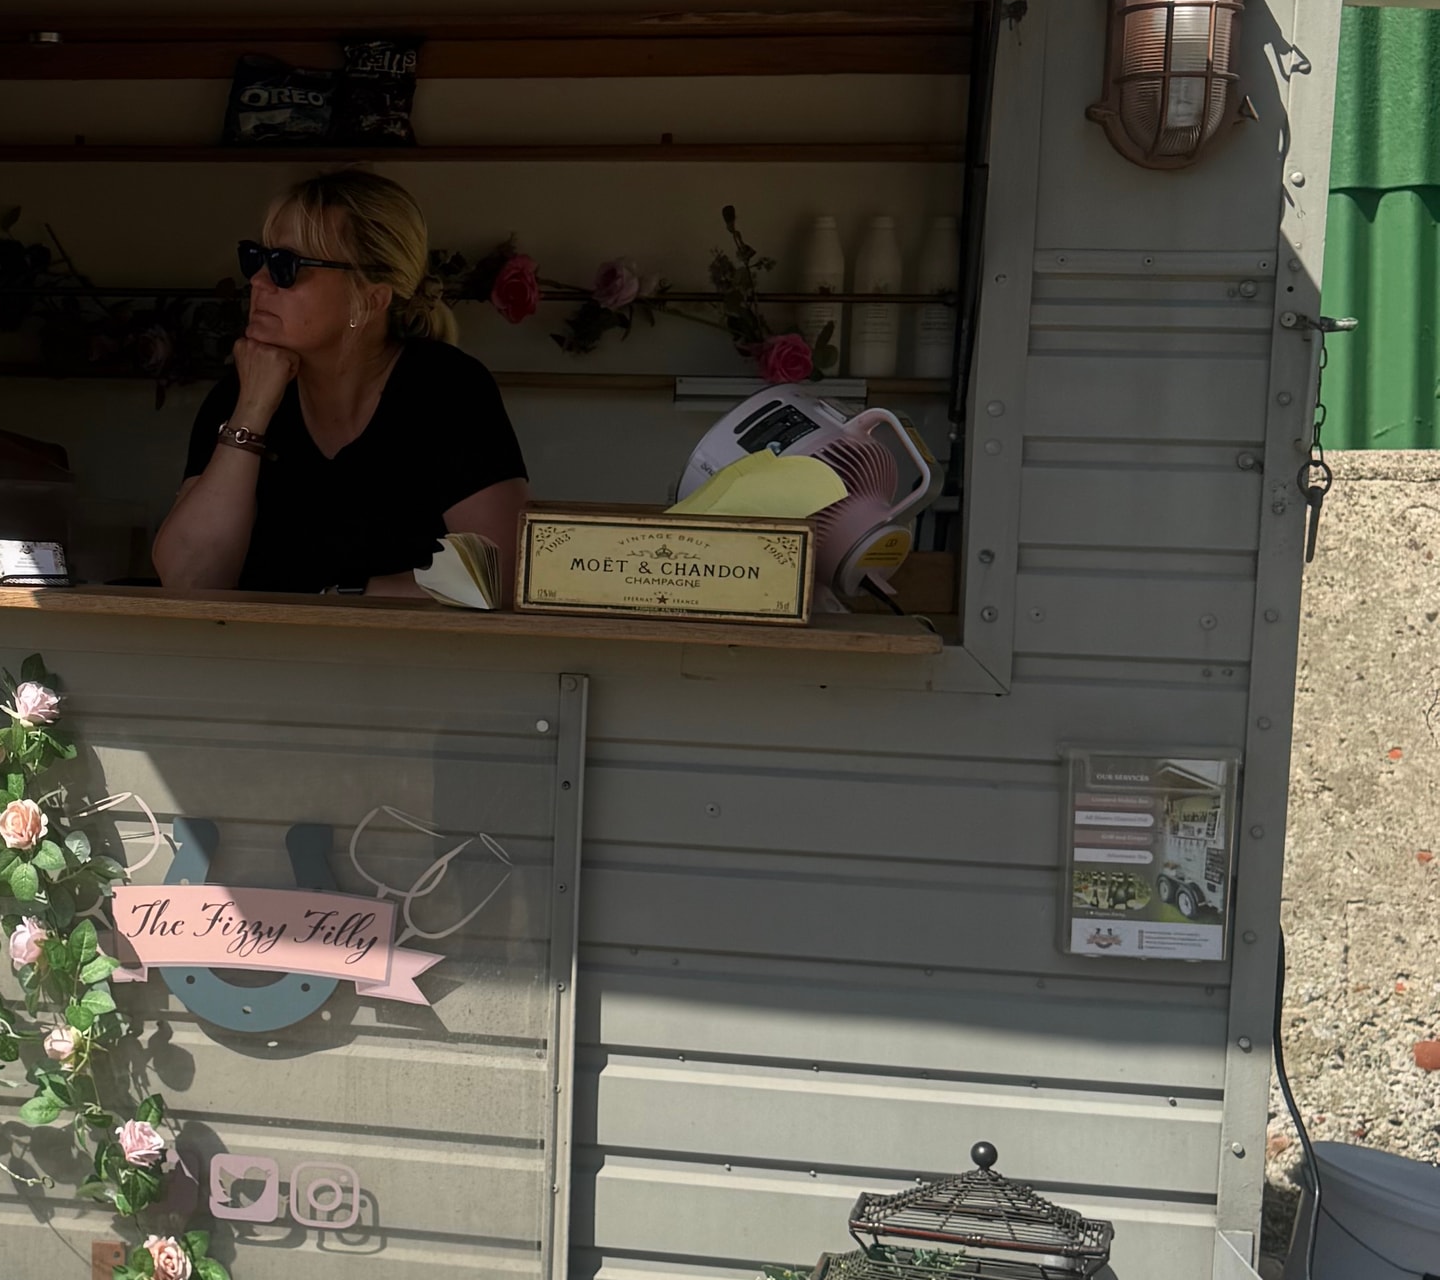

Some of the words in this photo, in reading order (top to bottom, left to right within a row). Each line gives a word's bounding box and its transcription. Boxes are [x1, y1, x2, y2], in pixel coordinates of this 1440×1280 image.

[240, 87, 324, 107] OREO
[544, 533, 572, 553] 1983
[618, 532, 673, 545] VINTAGE
[677, 534, 711, 549] BRUT
[763, 543, 789, 566] 1983
[570, 556, 629, 574] MOËT
[638, 561, 653, 575] &
[661, 562, 760, 579] CHANDON
[625, 576, 701, 588] CHAMPAGNE
[126, 898, 185, 939] The
[193, 901, 288, 957] Fizzy
[293, 908, 379, 965] Filly
